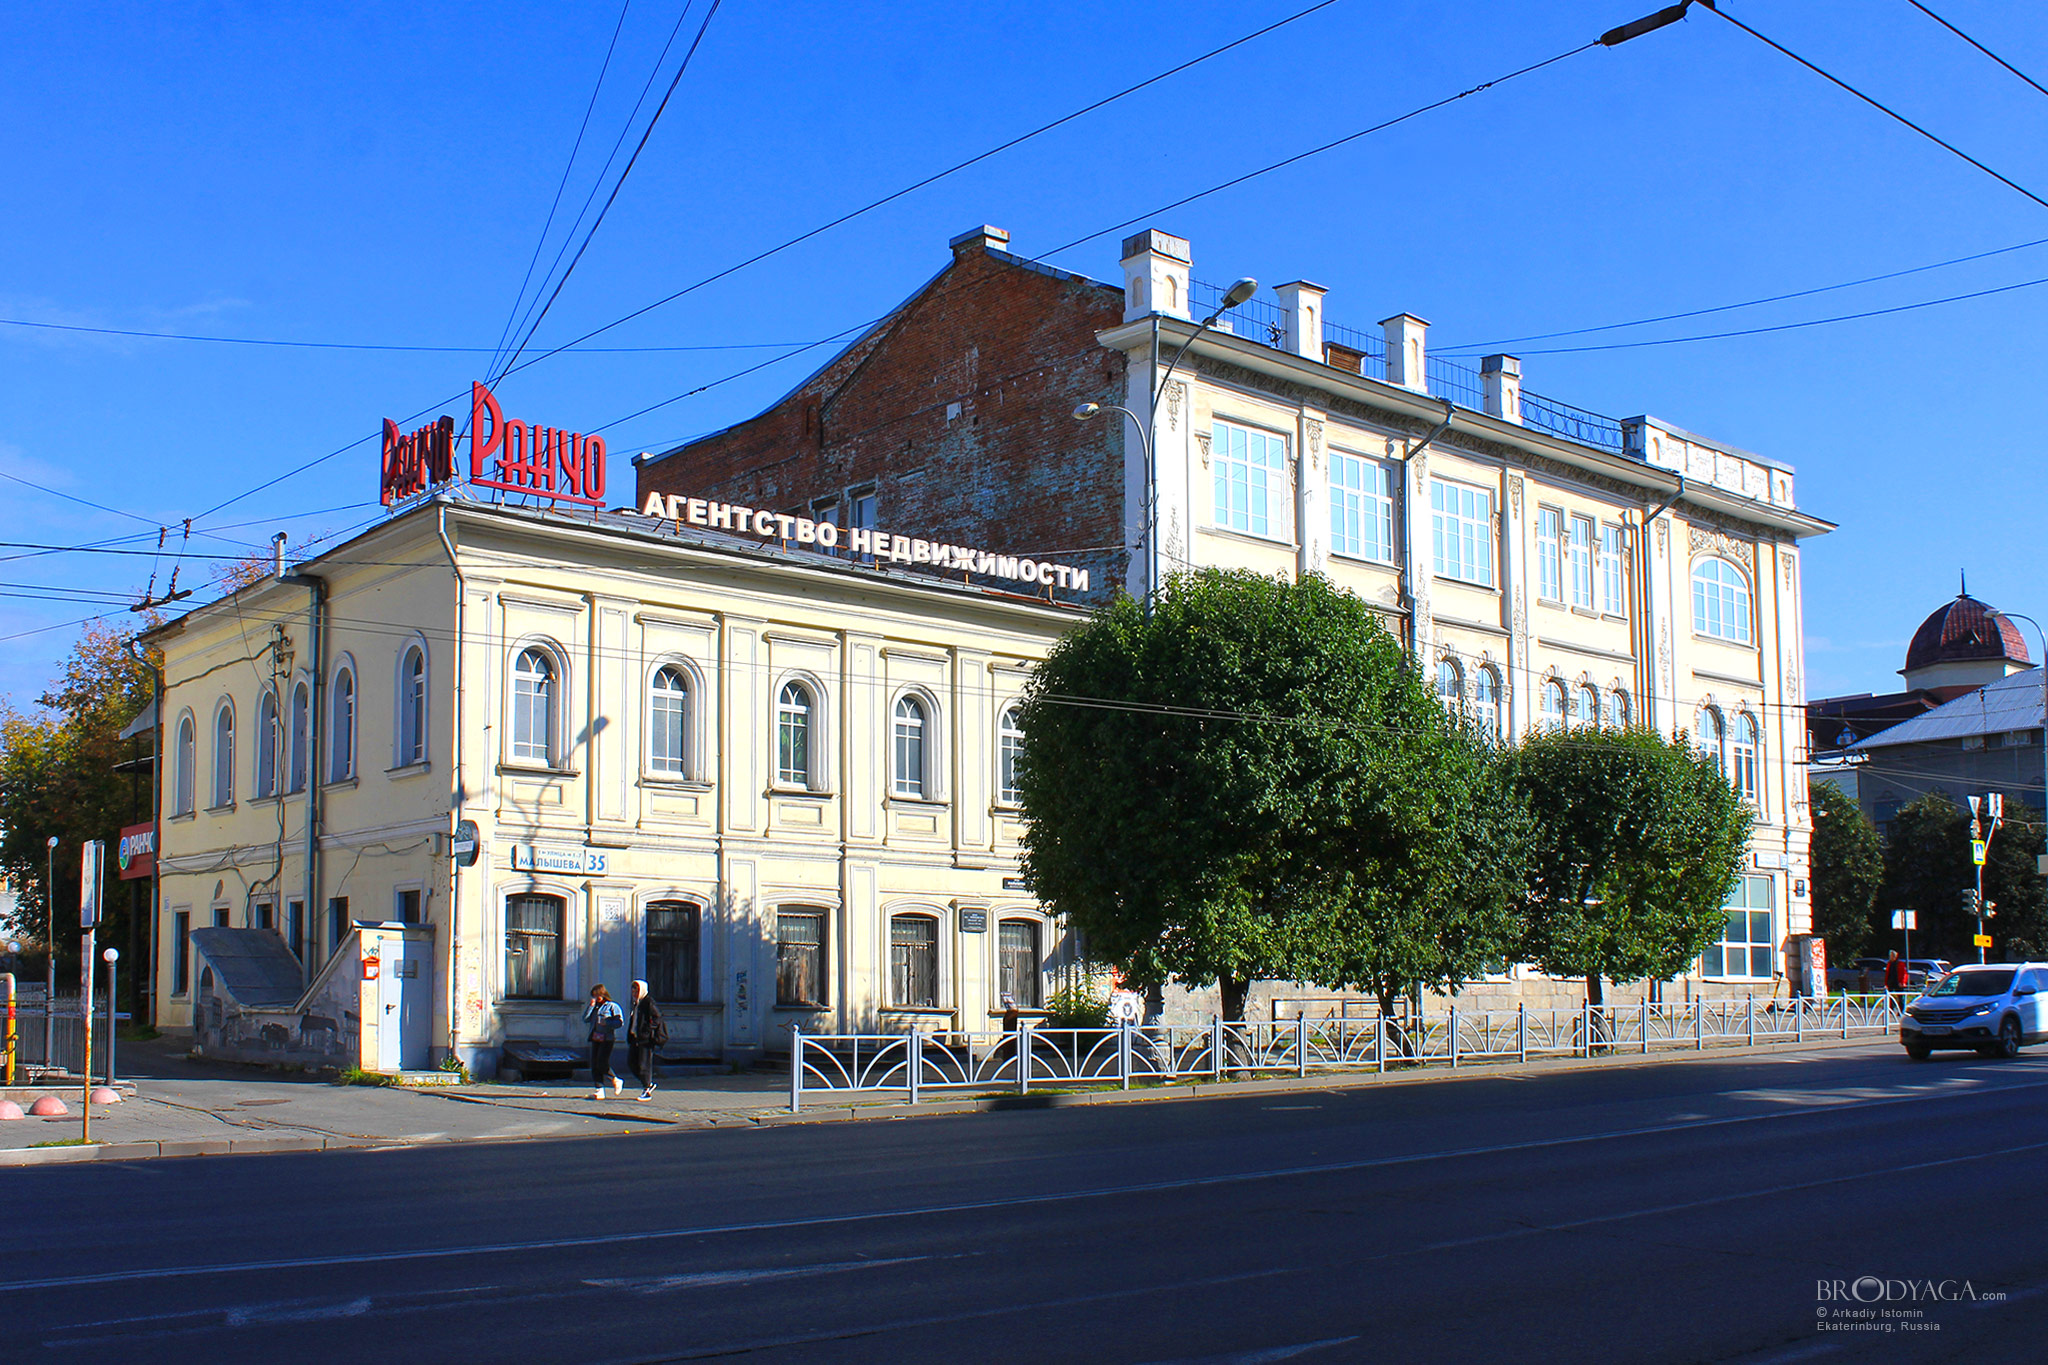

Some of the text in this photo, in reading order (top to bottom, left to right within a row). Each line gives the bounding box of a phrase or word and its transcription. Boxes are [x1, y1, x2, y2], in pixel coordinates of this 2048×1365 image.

[471, 380, 606, 499] РАНЧО
[643, 491, 1089, 591] АГЕНТСТВО НЕДВИЖИМОСТИ
[519, 857, 581, 870] МАЛЫШЕВА
[588, 855, 605, 871] 35
